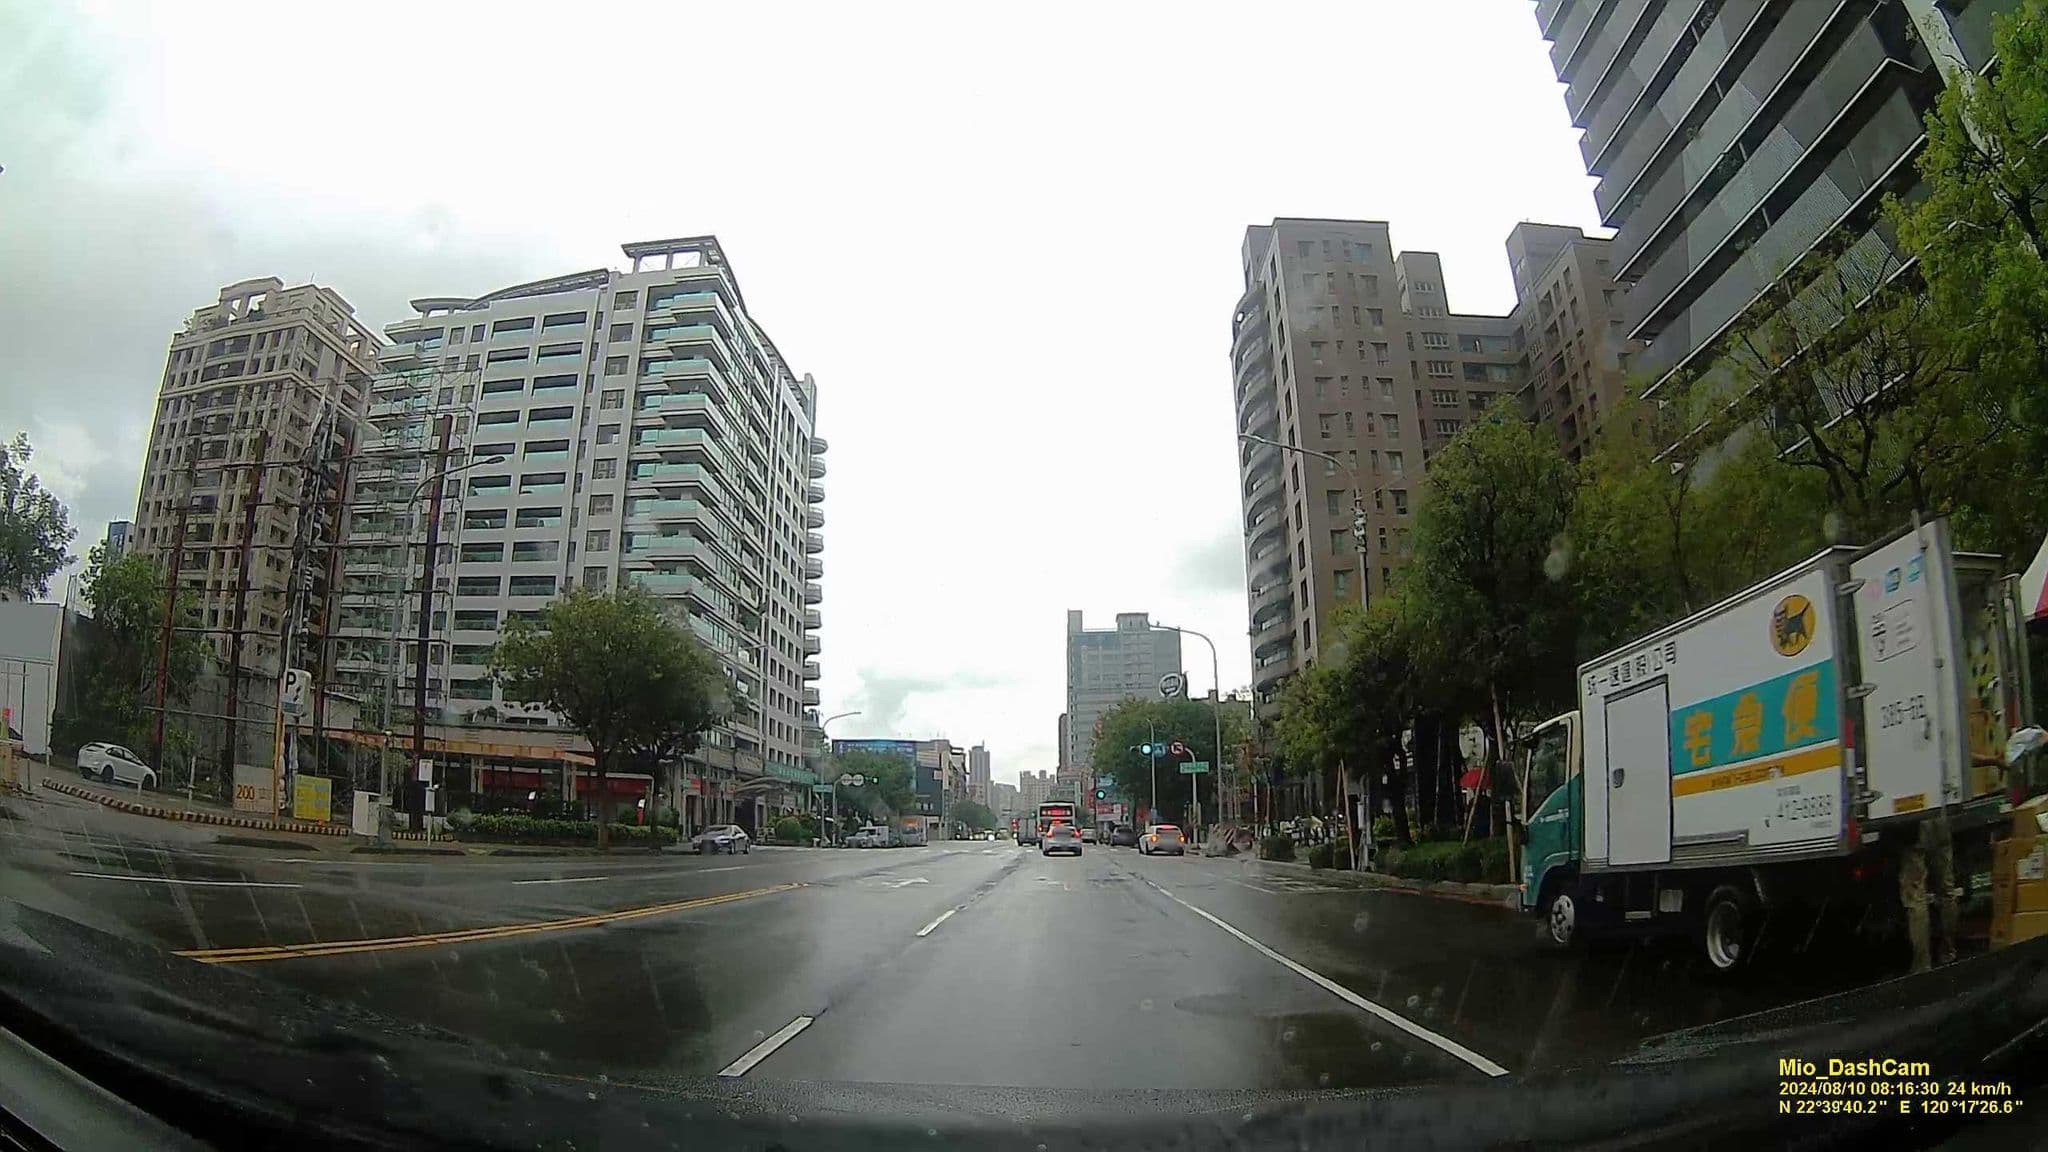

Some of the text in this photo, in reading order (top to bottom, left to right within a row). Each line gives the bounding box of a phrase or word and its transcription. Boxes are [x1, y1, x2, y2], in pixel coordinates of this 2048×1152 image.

[285, 671, 297, 693] P
[1684, 671, 1820, 767] 宅急便
[236, 784, 255, 800] 200
